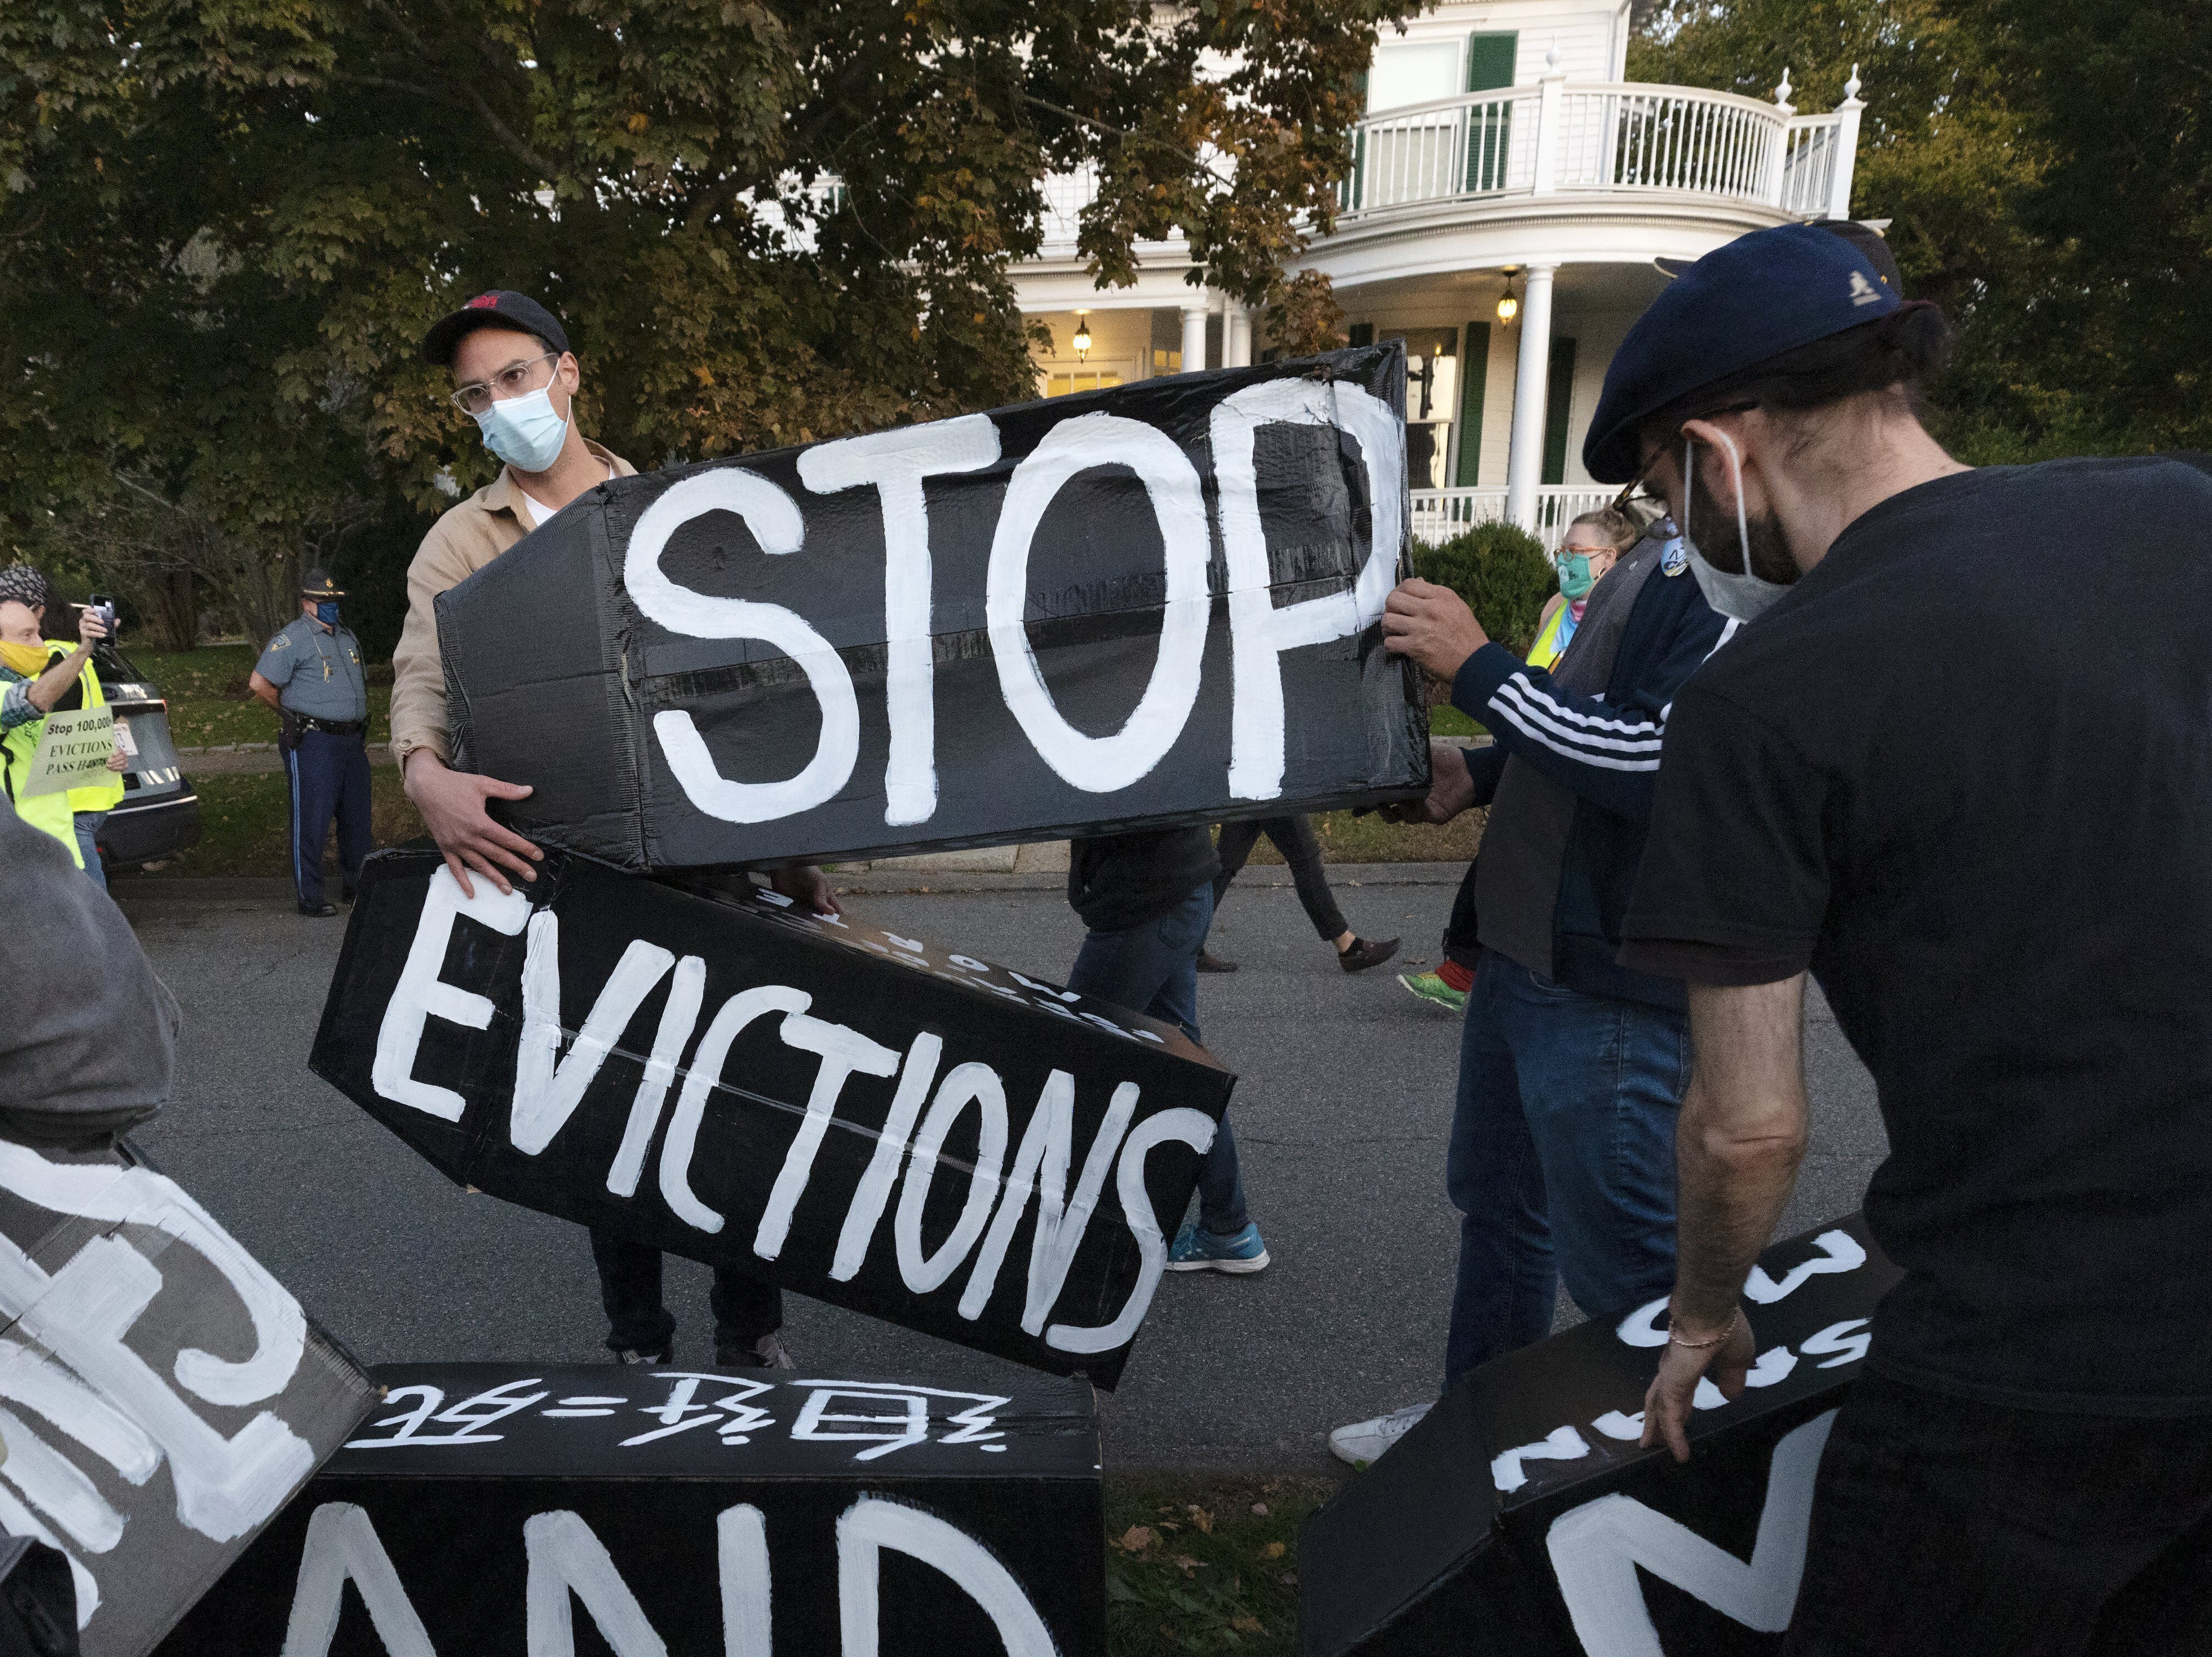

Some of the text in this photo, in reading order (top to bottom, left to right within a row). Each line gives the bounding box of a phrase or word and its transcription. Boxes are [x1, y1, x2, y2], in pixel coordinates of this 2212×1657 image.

[624, 378, 1406, 827] STOP
[48, 723, 72, 735] Stop
[50, 739, 113, 757] EVICTIONS
[45, 760, 74, 775] PASS
[756, 888, 1082, 1002] MORTE
[371, 863, 1218, 1355] EVICTIONS
